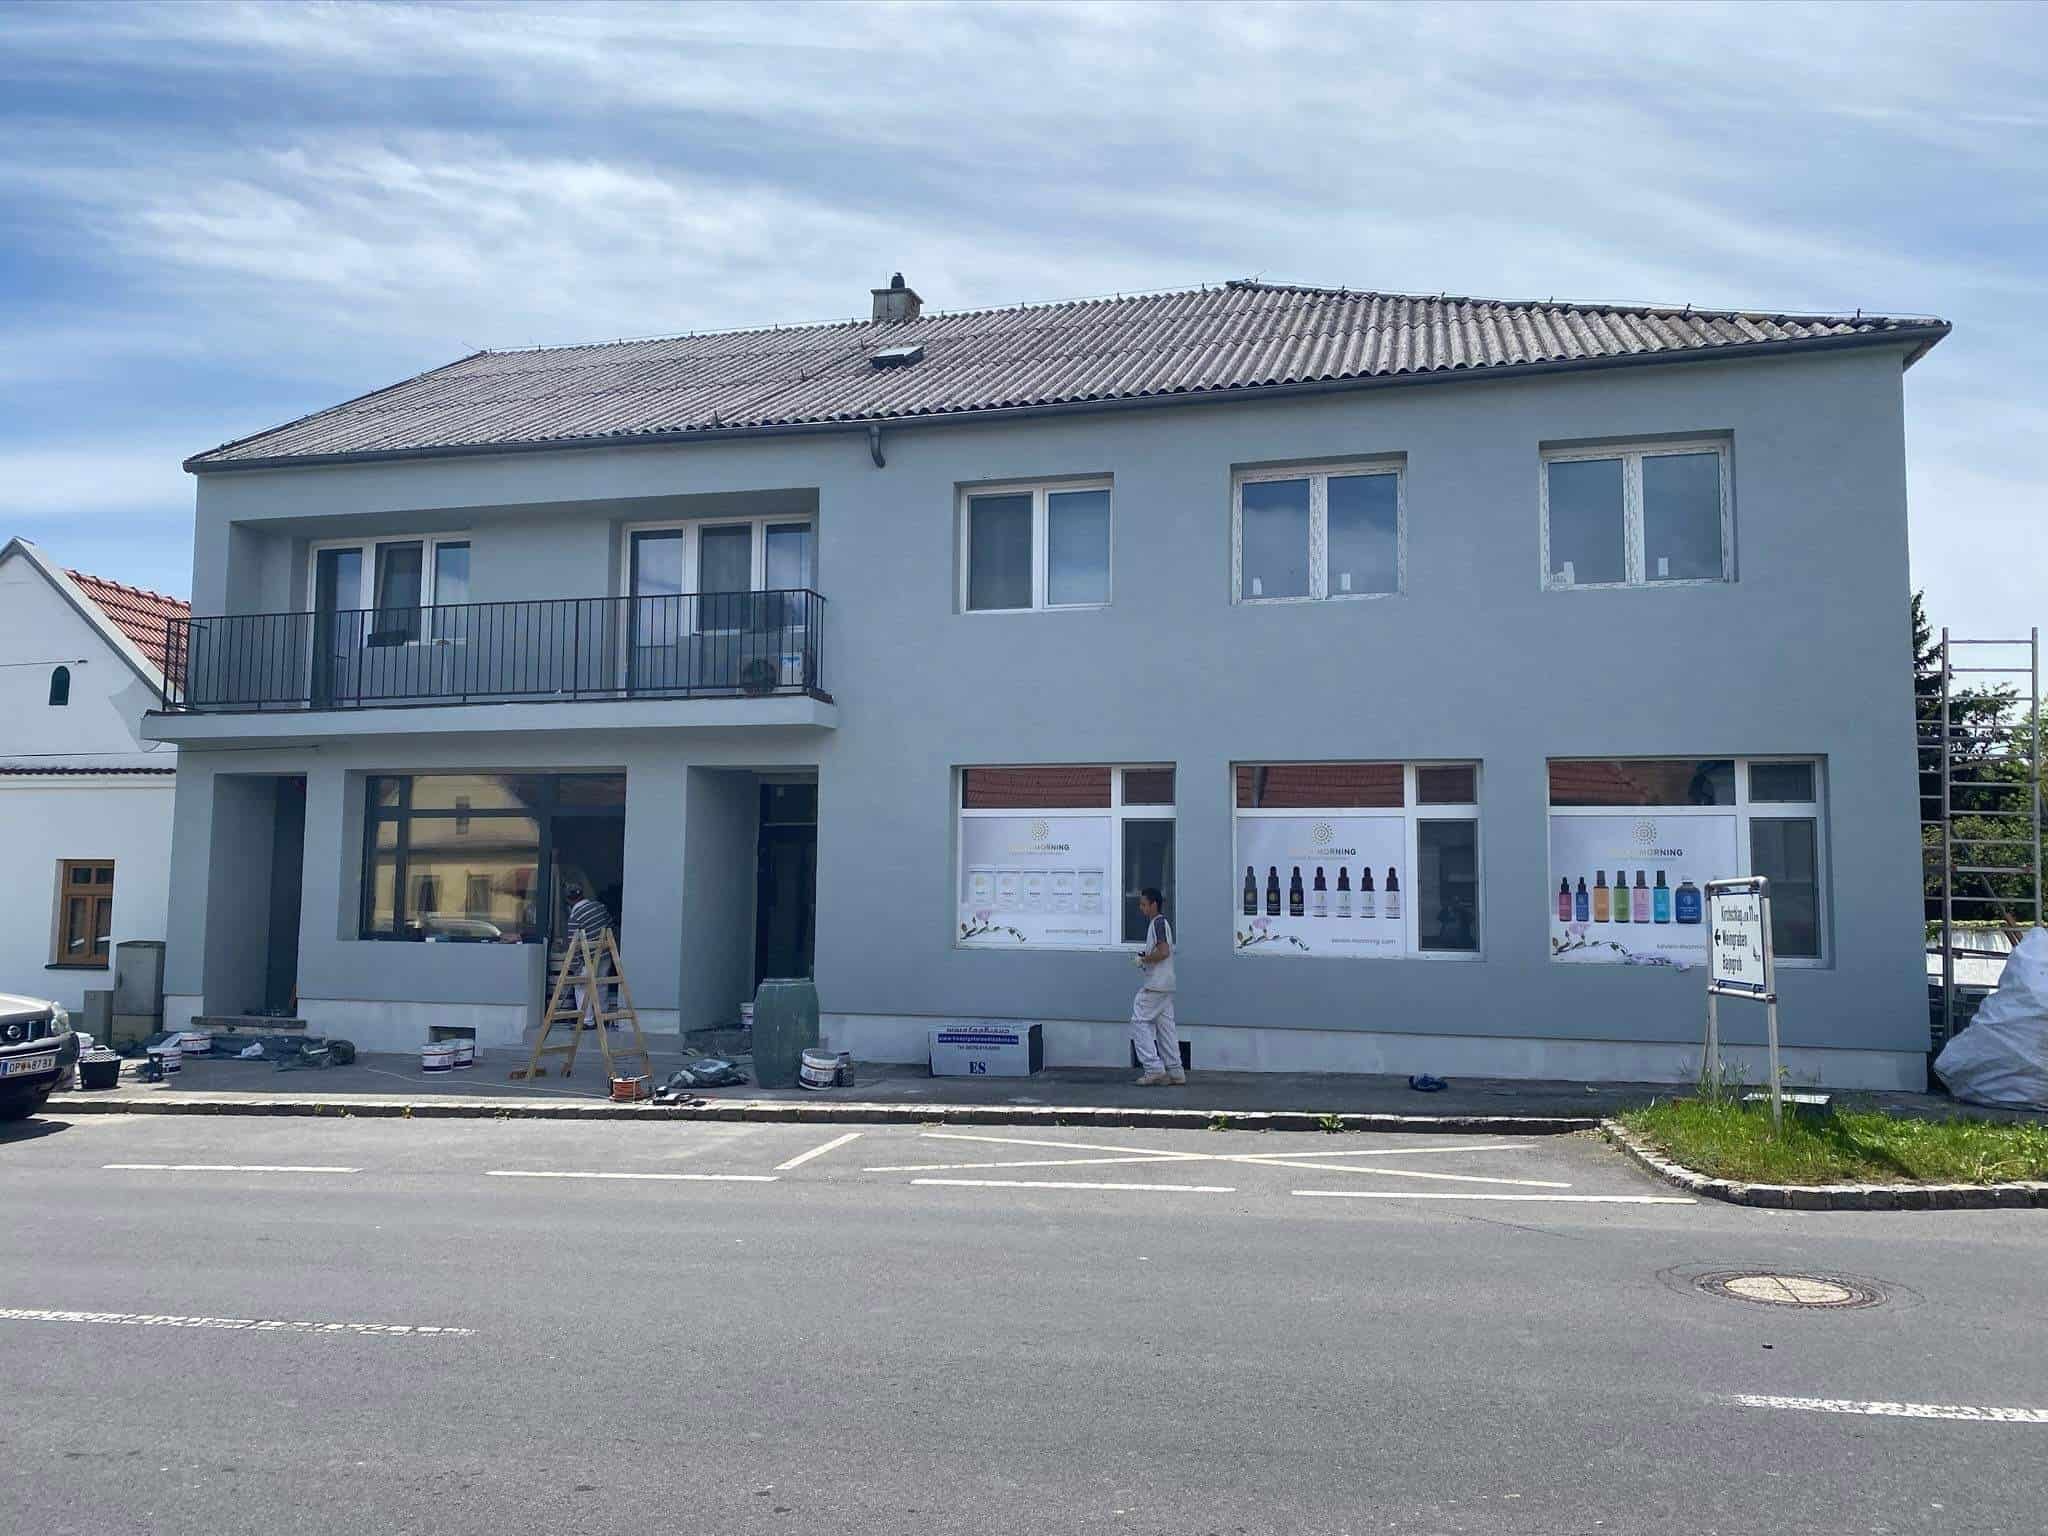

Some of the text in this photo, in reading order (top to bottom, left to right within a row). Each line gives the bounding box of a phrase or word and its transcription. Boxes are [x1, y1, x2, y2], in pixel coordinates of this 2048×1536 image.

[1317, 848, 1356, 856] MORNING
[1639, 848, 1684, 857] MORNING
[969, 1061, 986, 1075] ES
